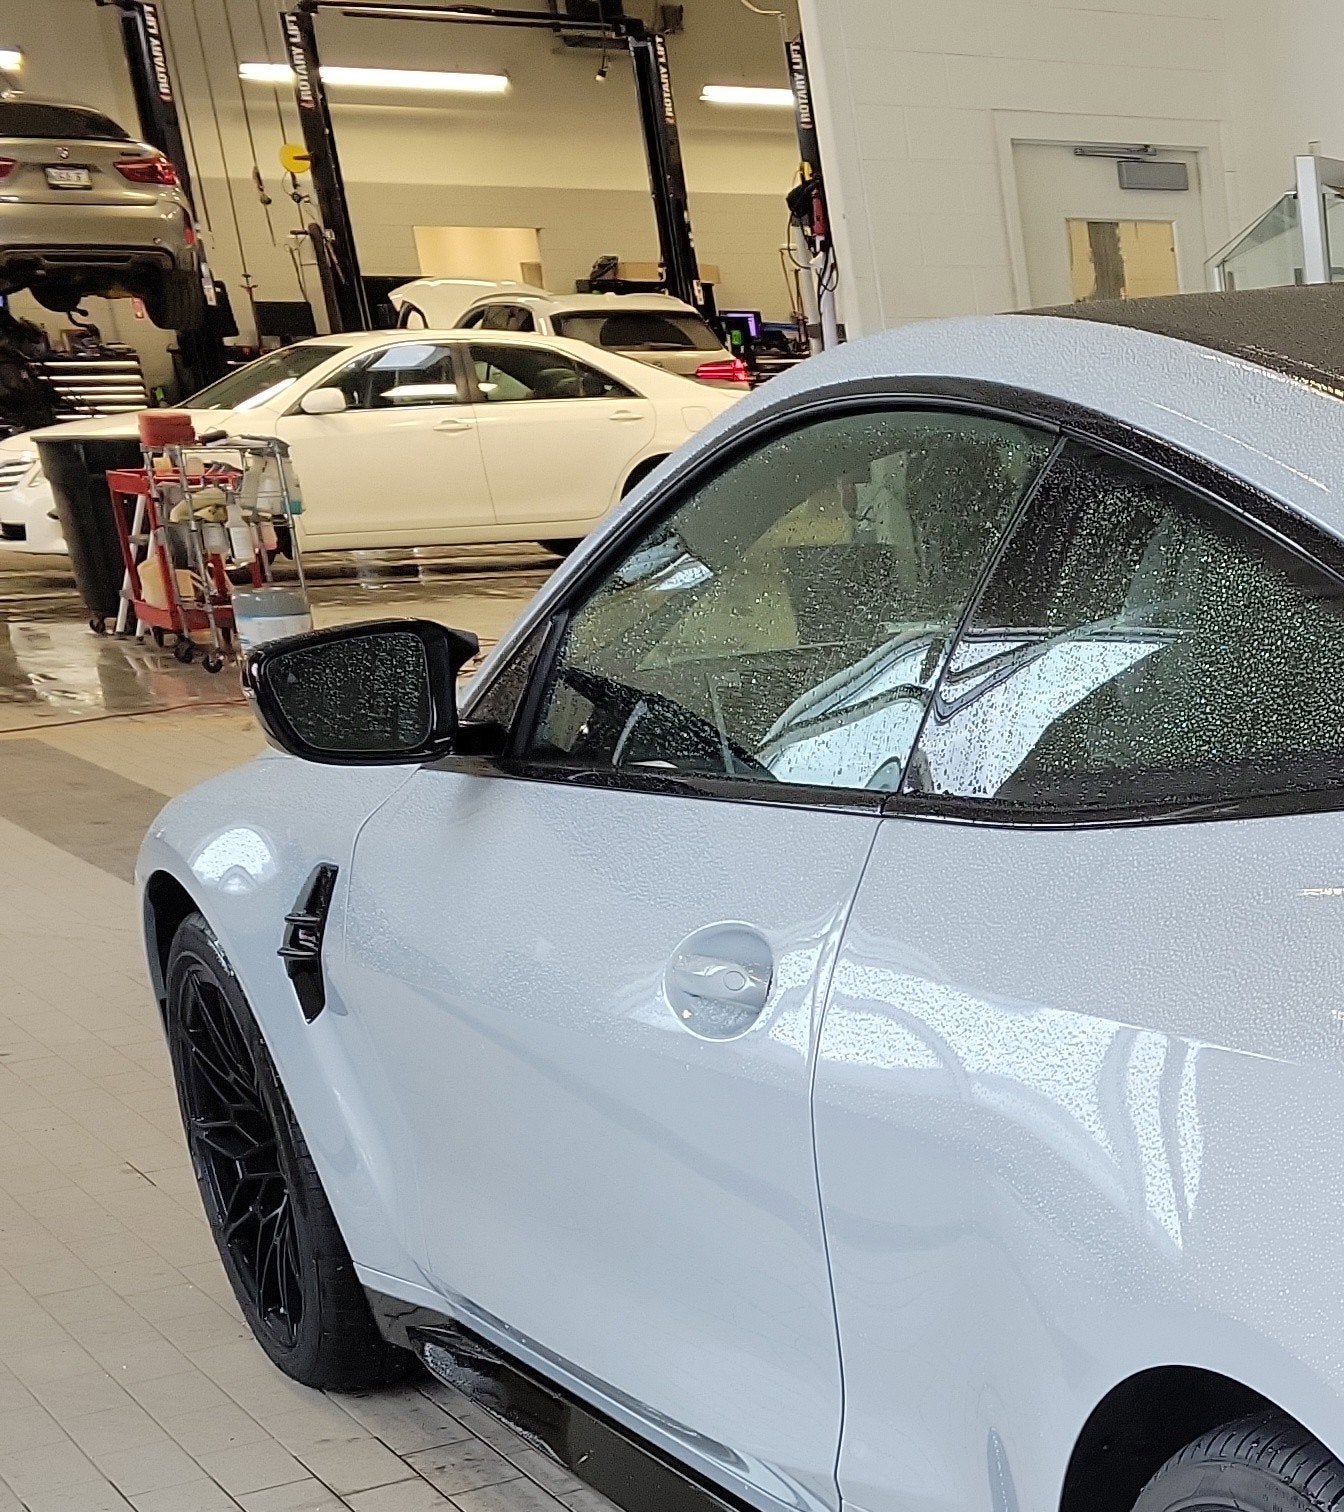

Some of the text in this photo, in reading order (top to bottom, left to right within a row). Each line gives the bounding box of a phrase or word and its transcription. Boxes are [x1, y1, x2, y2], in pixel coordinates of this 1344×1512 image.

[143, 4, 171, 95] ROTARY LIFT
[285, 13, 313, 101] ROTARY LIFT
[655, 34, 675, 117] ROTARY LIFT
[789, 42, 812, 122] ROTARY LIFT
